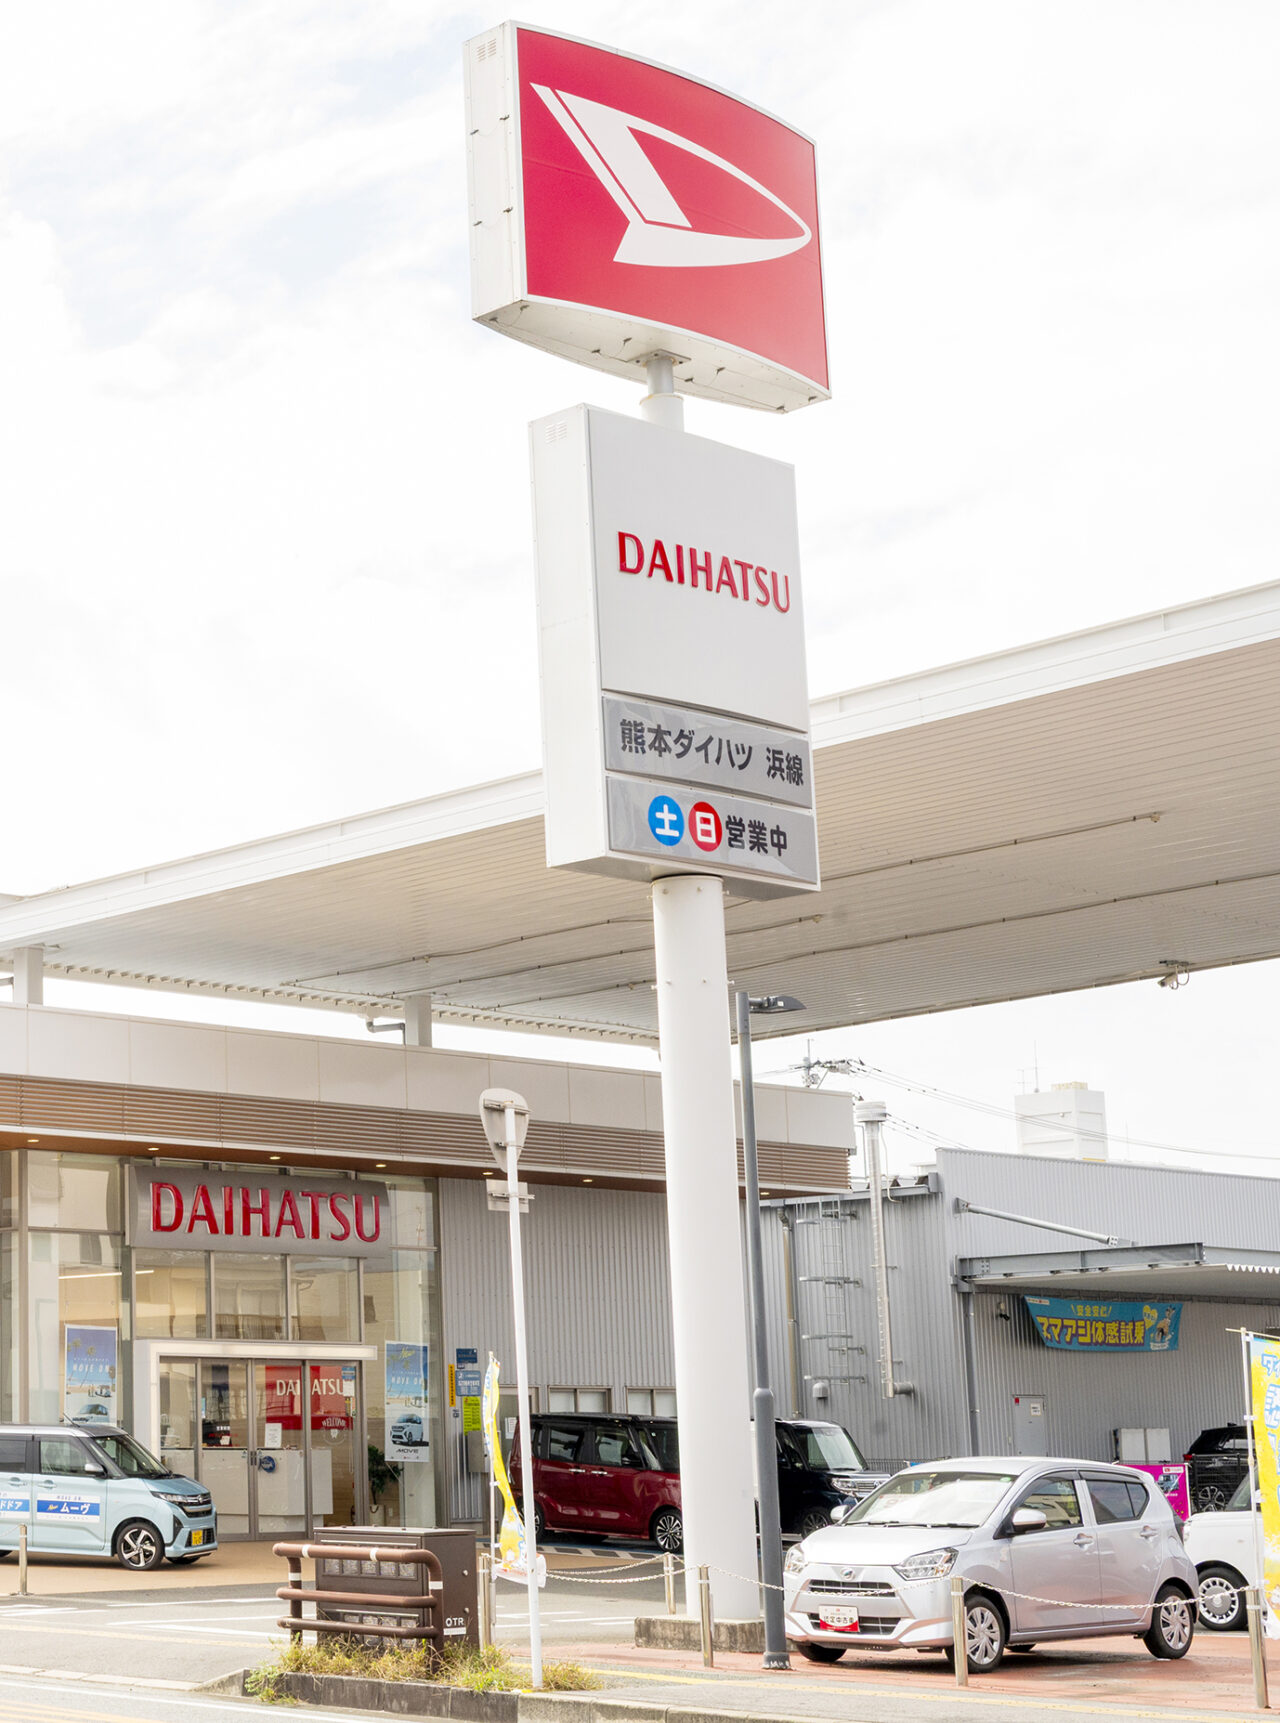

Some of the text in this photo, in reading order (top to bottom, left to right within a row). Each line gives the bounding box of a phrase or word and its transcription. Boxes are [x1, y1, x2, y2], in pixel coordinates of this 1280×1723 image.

[618, 531, 790, 613] DAIHATSU
[620, 719, 805, 786] 熊本ダイハツ 浜線
[150, 1182, 381, 1243] DAIHATSU
[1036, 1315, 1146, 1344] スマアシ体感試乗
[60, 1501, 91, 1515] ムーヴ
[445, 1617, 465, 1627] OTR
